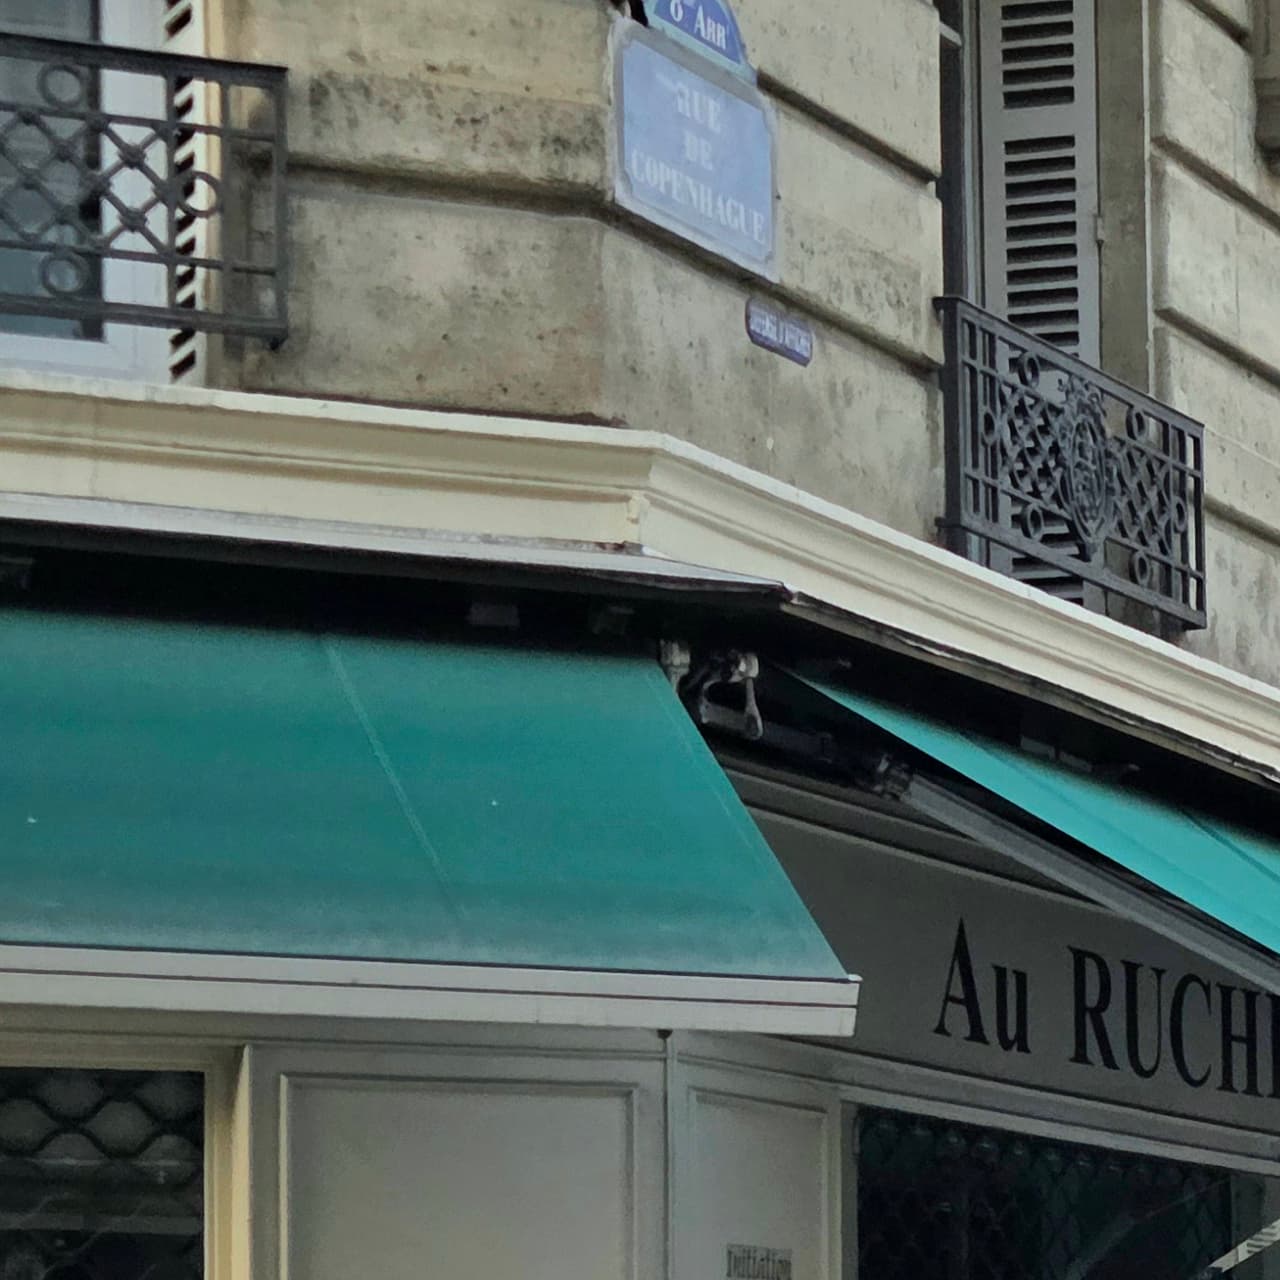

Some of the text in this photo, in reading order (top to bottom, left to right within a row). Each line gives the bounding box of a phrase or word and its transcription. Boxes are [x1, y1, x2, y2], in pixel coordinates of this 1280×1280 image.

[677, 82, 721, 134] RUE
[685, 128, 713, 171] DE
[631, 148, 766, 245] COPENHAGUE
[933, 917, 1031, 1053] Au
